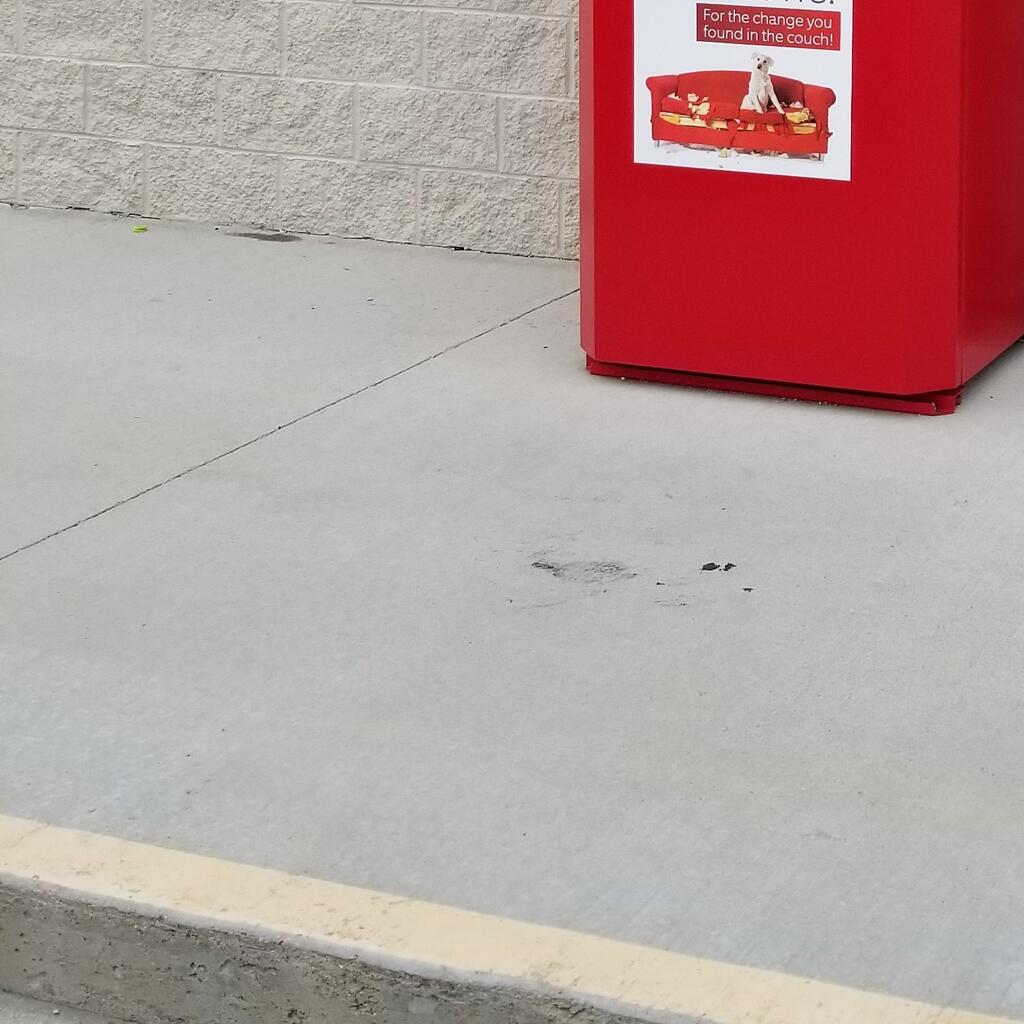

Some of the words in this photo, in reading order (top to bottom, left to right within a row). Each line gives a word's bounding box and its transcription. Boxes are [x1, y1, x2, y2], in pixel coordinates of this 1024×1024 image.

[703, 8, 725, 22] For
[728, 10, 750, 24] the
[752, 11, 803, 30] change
[806, 17, 833, 32] you
[703, 25, 743, 40] found
[747, 27, 758, 40] in
[762, 28, 784, 43] the
[787, 31, 834, 46] couch!
